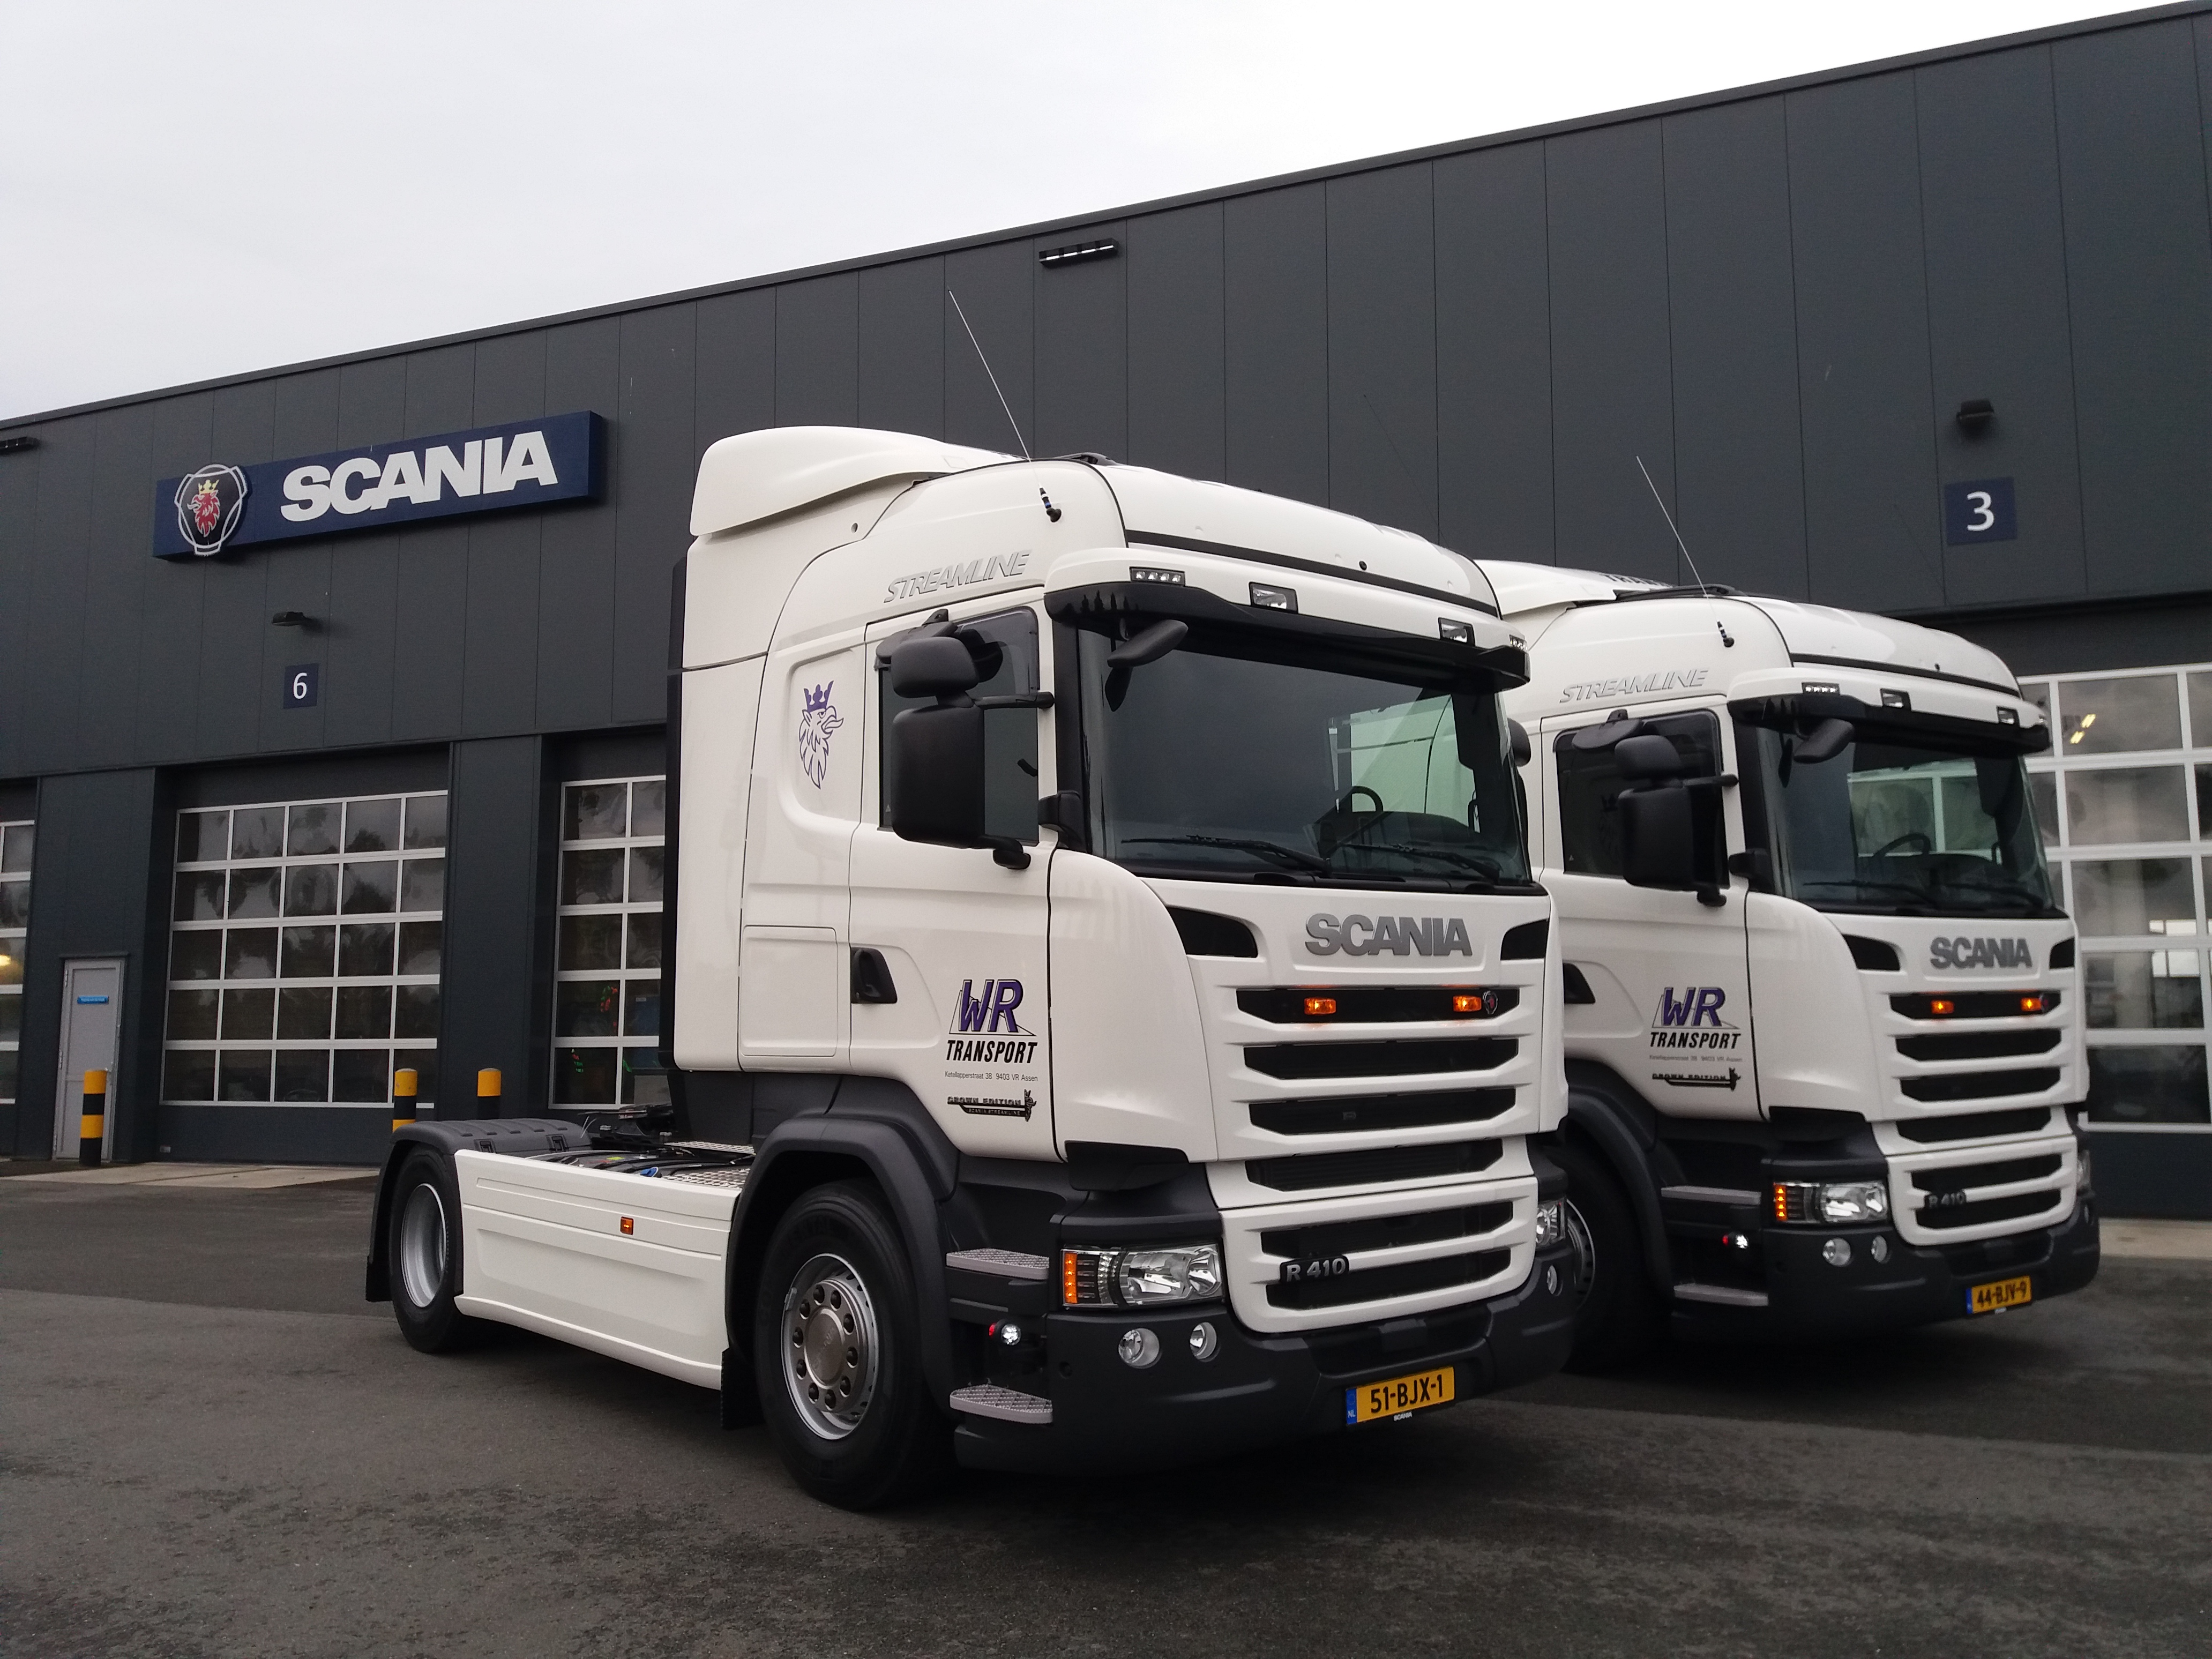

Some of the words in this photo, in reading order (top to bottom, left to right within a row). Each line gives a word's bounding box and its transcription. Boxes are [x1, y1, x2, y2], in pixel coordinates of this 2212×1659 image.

[280, 430, 558, 522] SCANIA
[1967, 491, 1994, 532] 3
[884, 549, 1032, 603] STREAMLINE
[293, 672, 308, 699] 6
[1559, 668, 1708, 703] STREAMLINE
[1305, 913, 1473, 956] SCANIA
[1930, 937, 2032, 969] SCANIA
[958, 979, 1023, 1033] WR
[1662, 987, 1725, 1027] WR
[946, 1040, 1038, 1064] TRANSPORT
[1650, 1032, 1741, 1049] TRANSPORT
[1941, 1191, 1965, 1205] 410
[1287, 1264, 1301, 1282] R
[1306, 1258, 1347, 1279] 410
[1371, 1374, 1443, 1414] 51-BJX-1
[1348, 1410, 1356, 1418] NL
[1394, 1411, 1413, 1421] SCANIA
